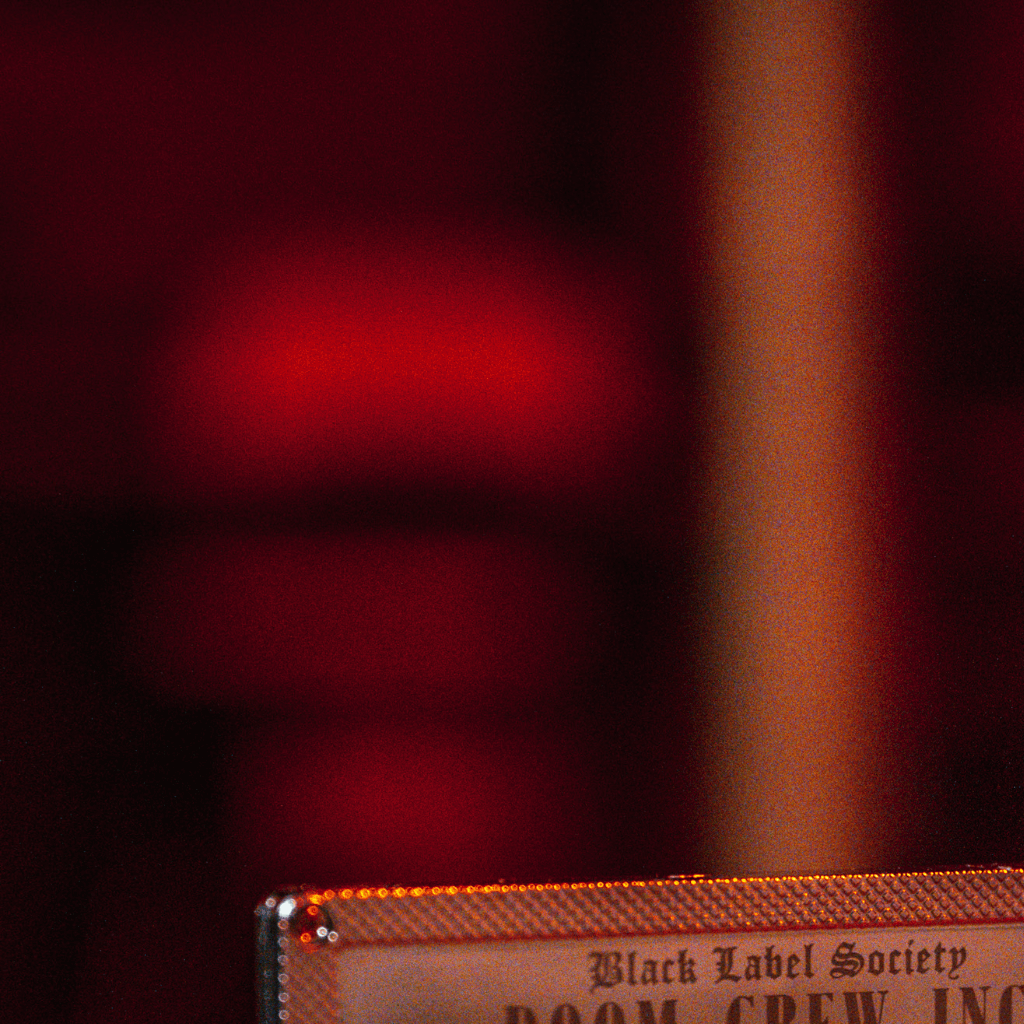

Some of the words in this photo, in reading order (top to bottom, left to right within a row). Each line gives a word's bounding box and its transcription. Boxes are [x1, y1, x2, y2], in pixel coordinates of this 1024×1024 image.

[589, 949, 697, 994] Black
[713, 943, 814, 985] Label
[830, 939, 969, 981] Society
